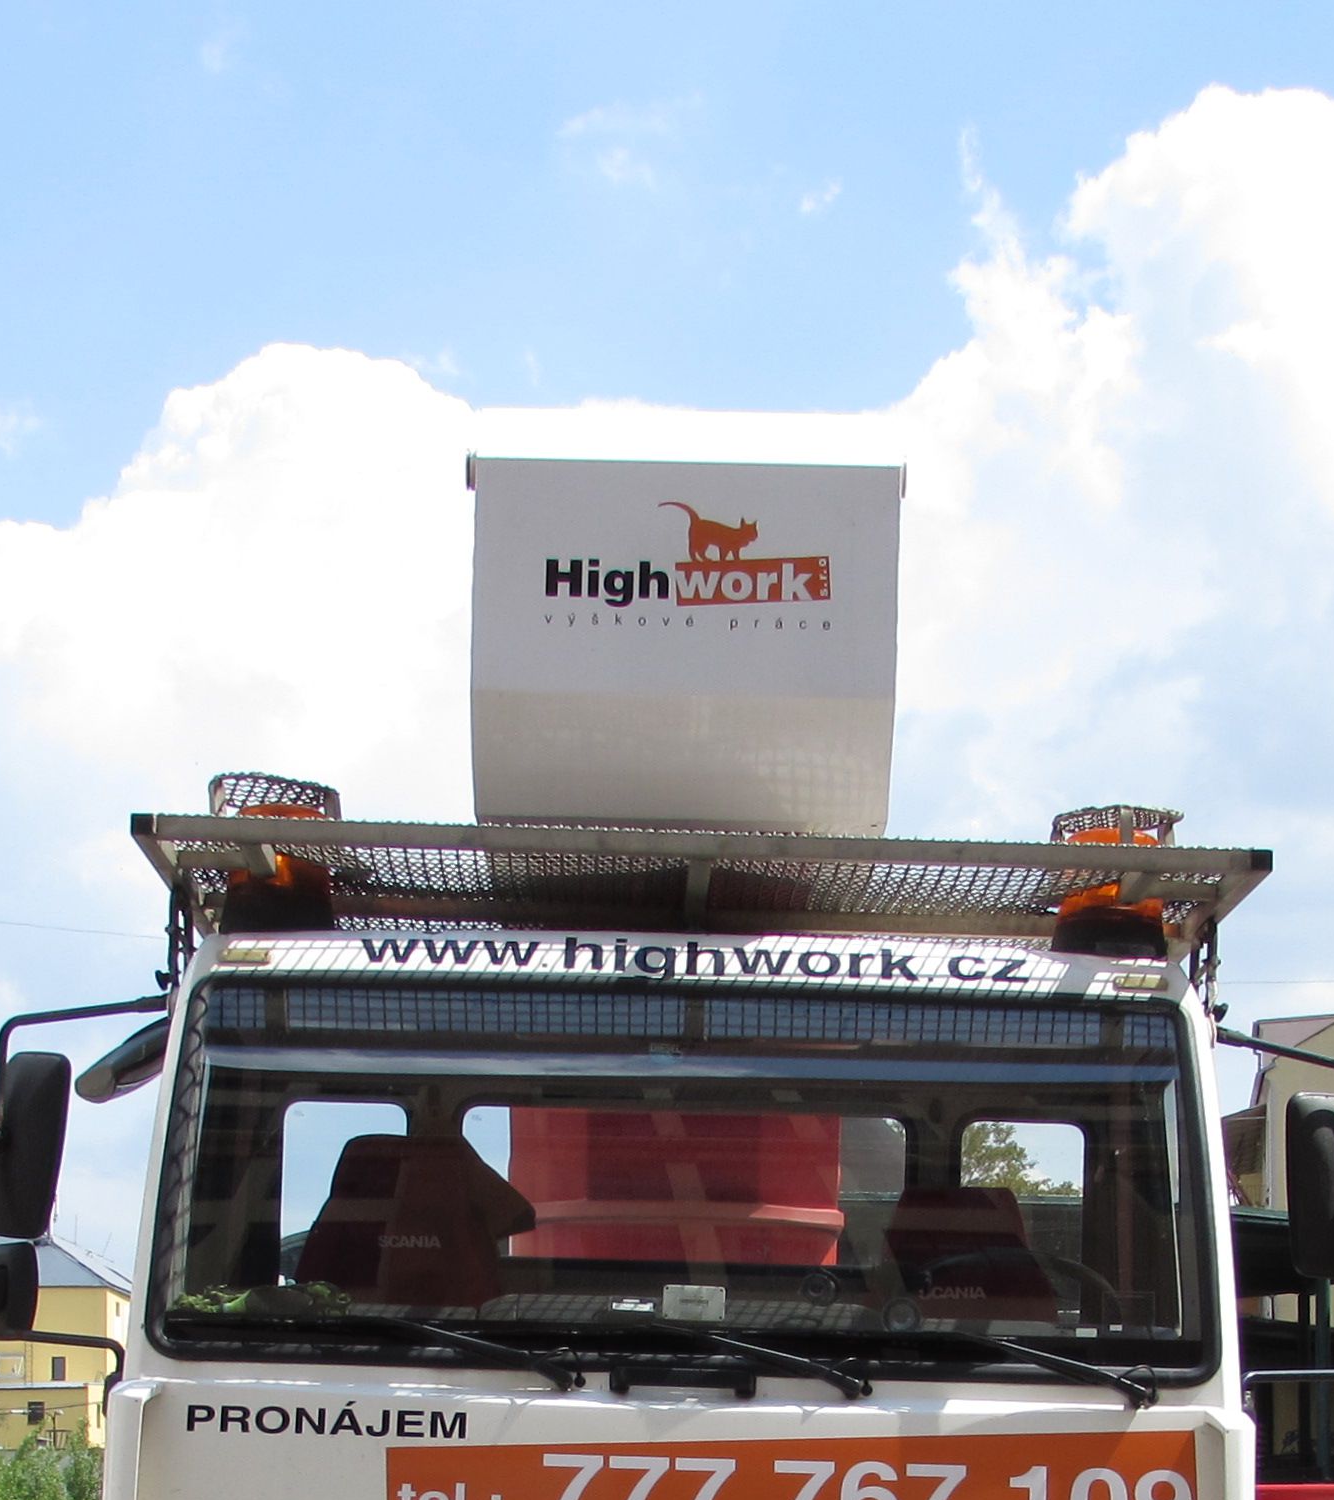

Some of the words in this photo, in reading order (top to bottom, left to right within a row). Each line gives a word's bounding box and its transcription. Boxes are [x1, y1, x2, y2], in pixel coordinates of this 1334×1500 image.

[544, 614, 694, 628] výškové
[729, 617, 831, 631] práce
[361, 937, 1030, 983] www.highwork.cz
[378, 1235, 441, 1248] SCANIA
[186, 1401, 468, 1439] PRONÁJEM
